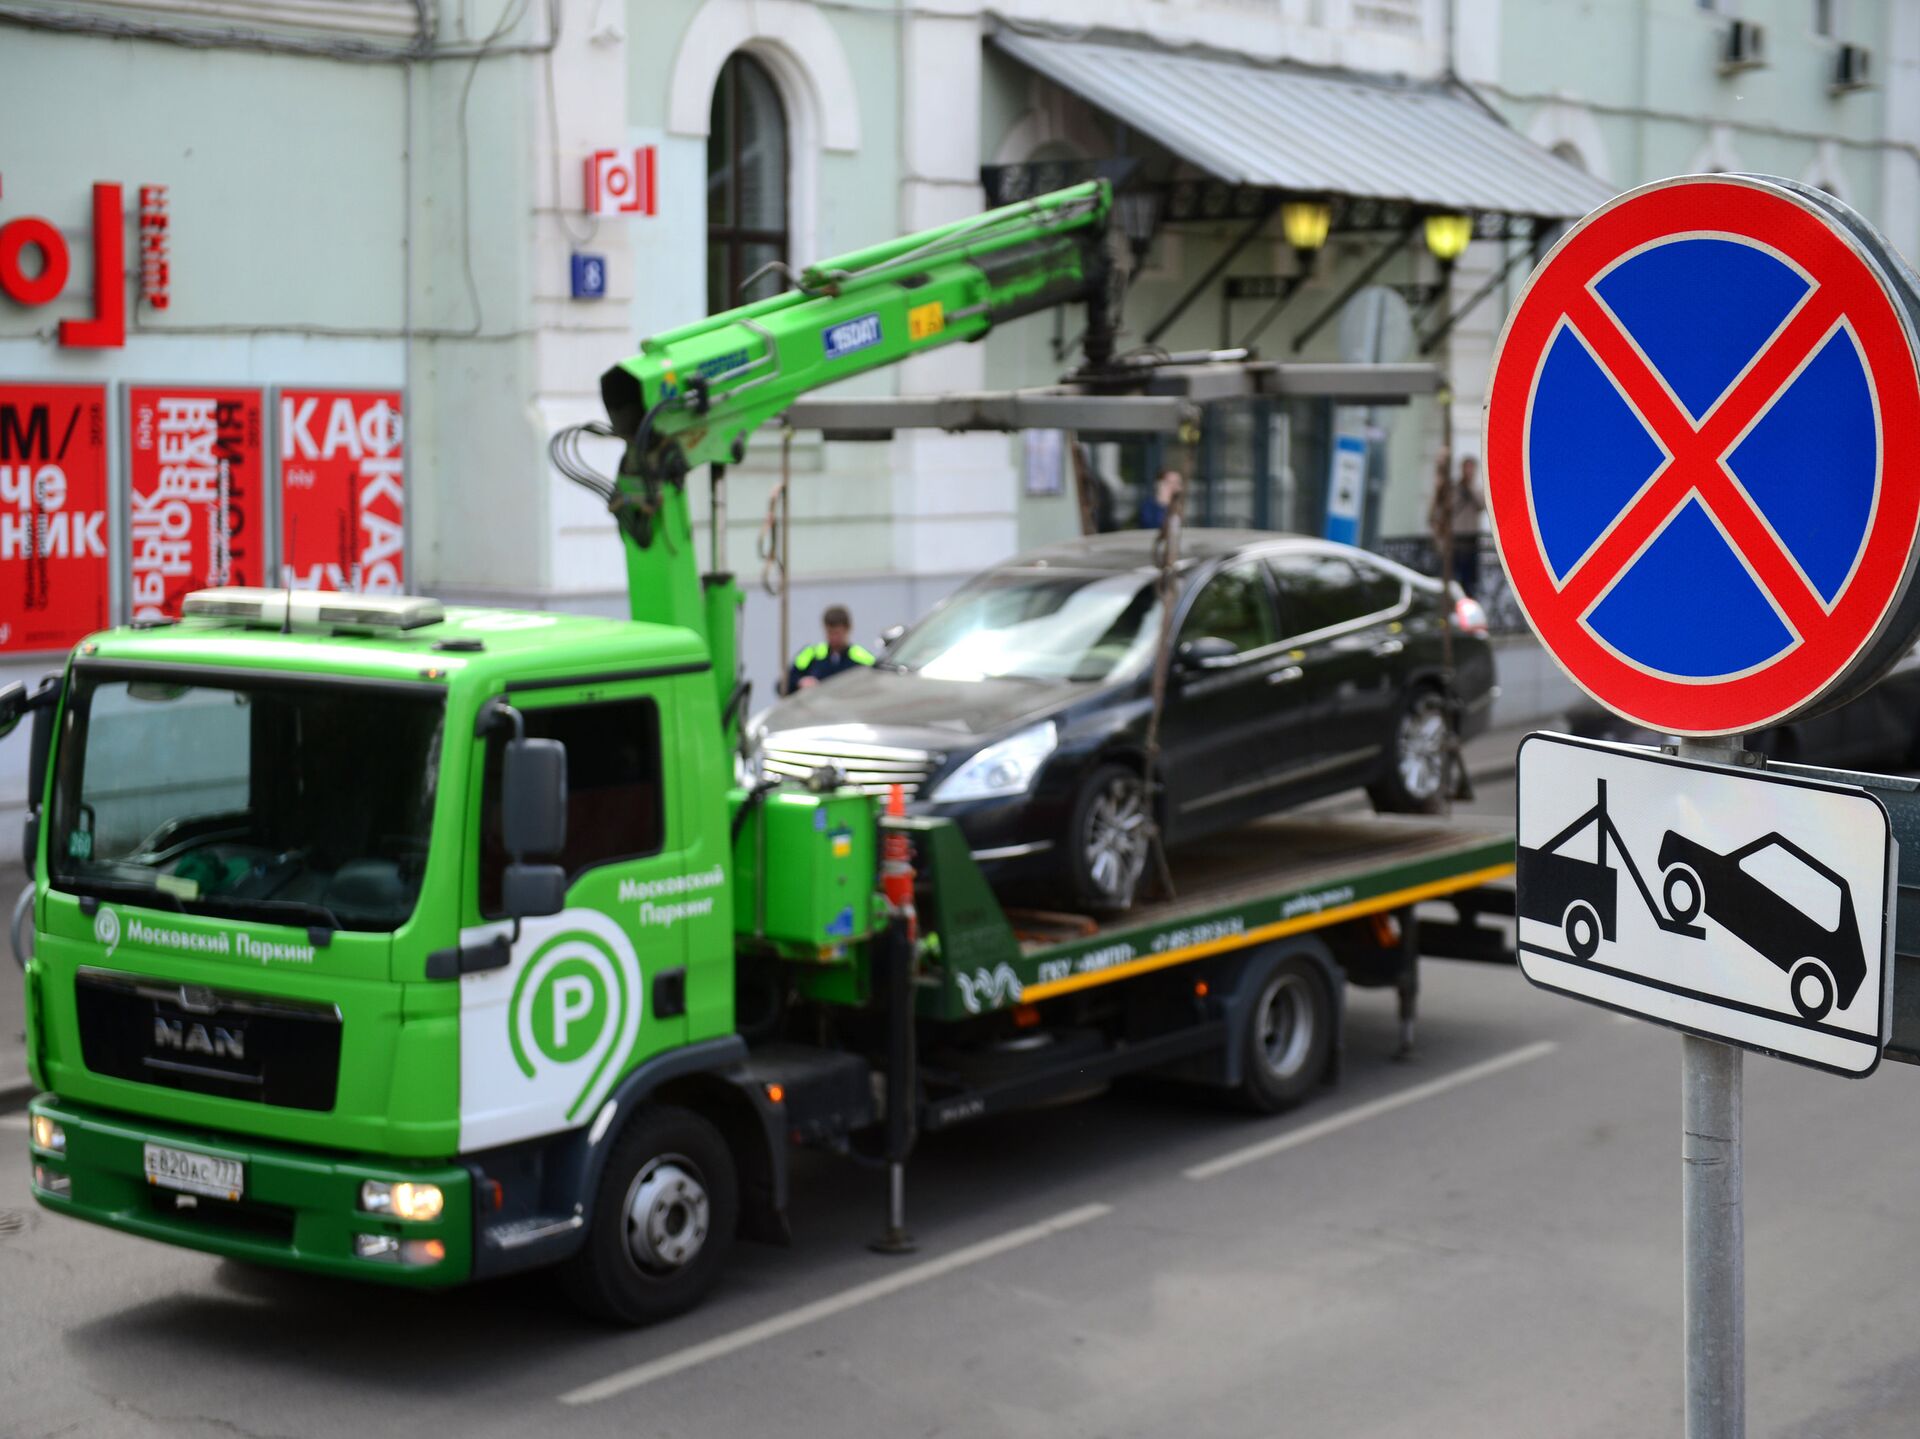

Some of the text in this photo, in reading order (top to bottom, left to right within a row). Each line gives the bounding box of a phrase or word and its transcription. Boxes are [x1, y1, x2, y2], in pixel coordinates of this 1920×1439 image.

[618, 864, 725, 902] Московский
[127, 918, 316, 966] Московский Паркинг
[154, 1016, 244, 1059] MAN
